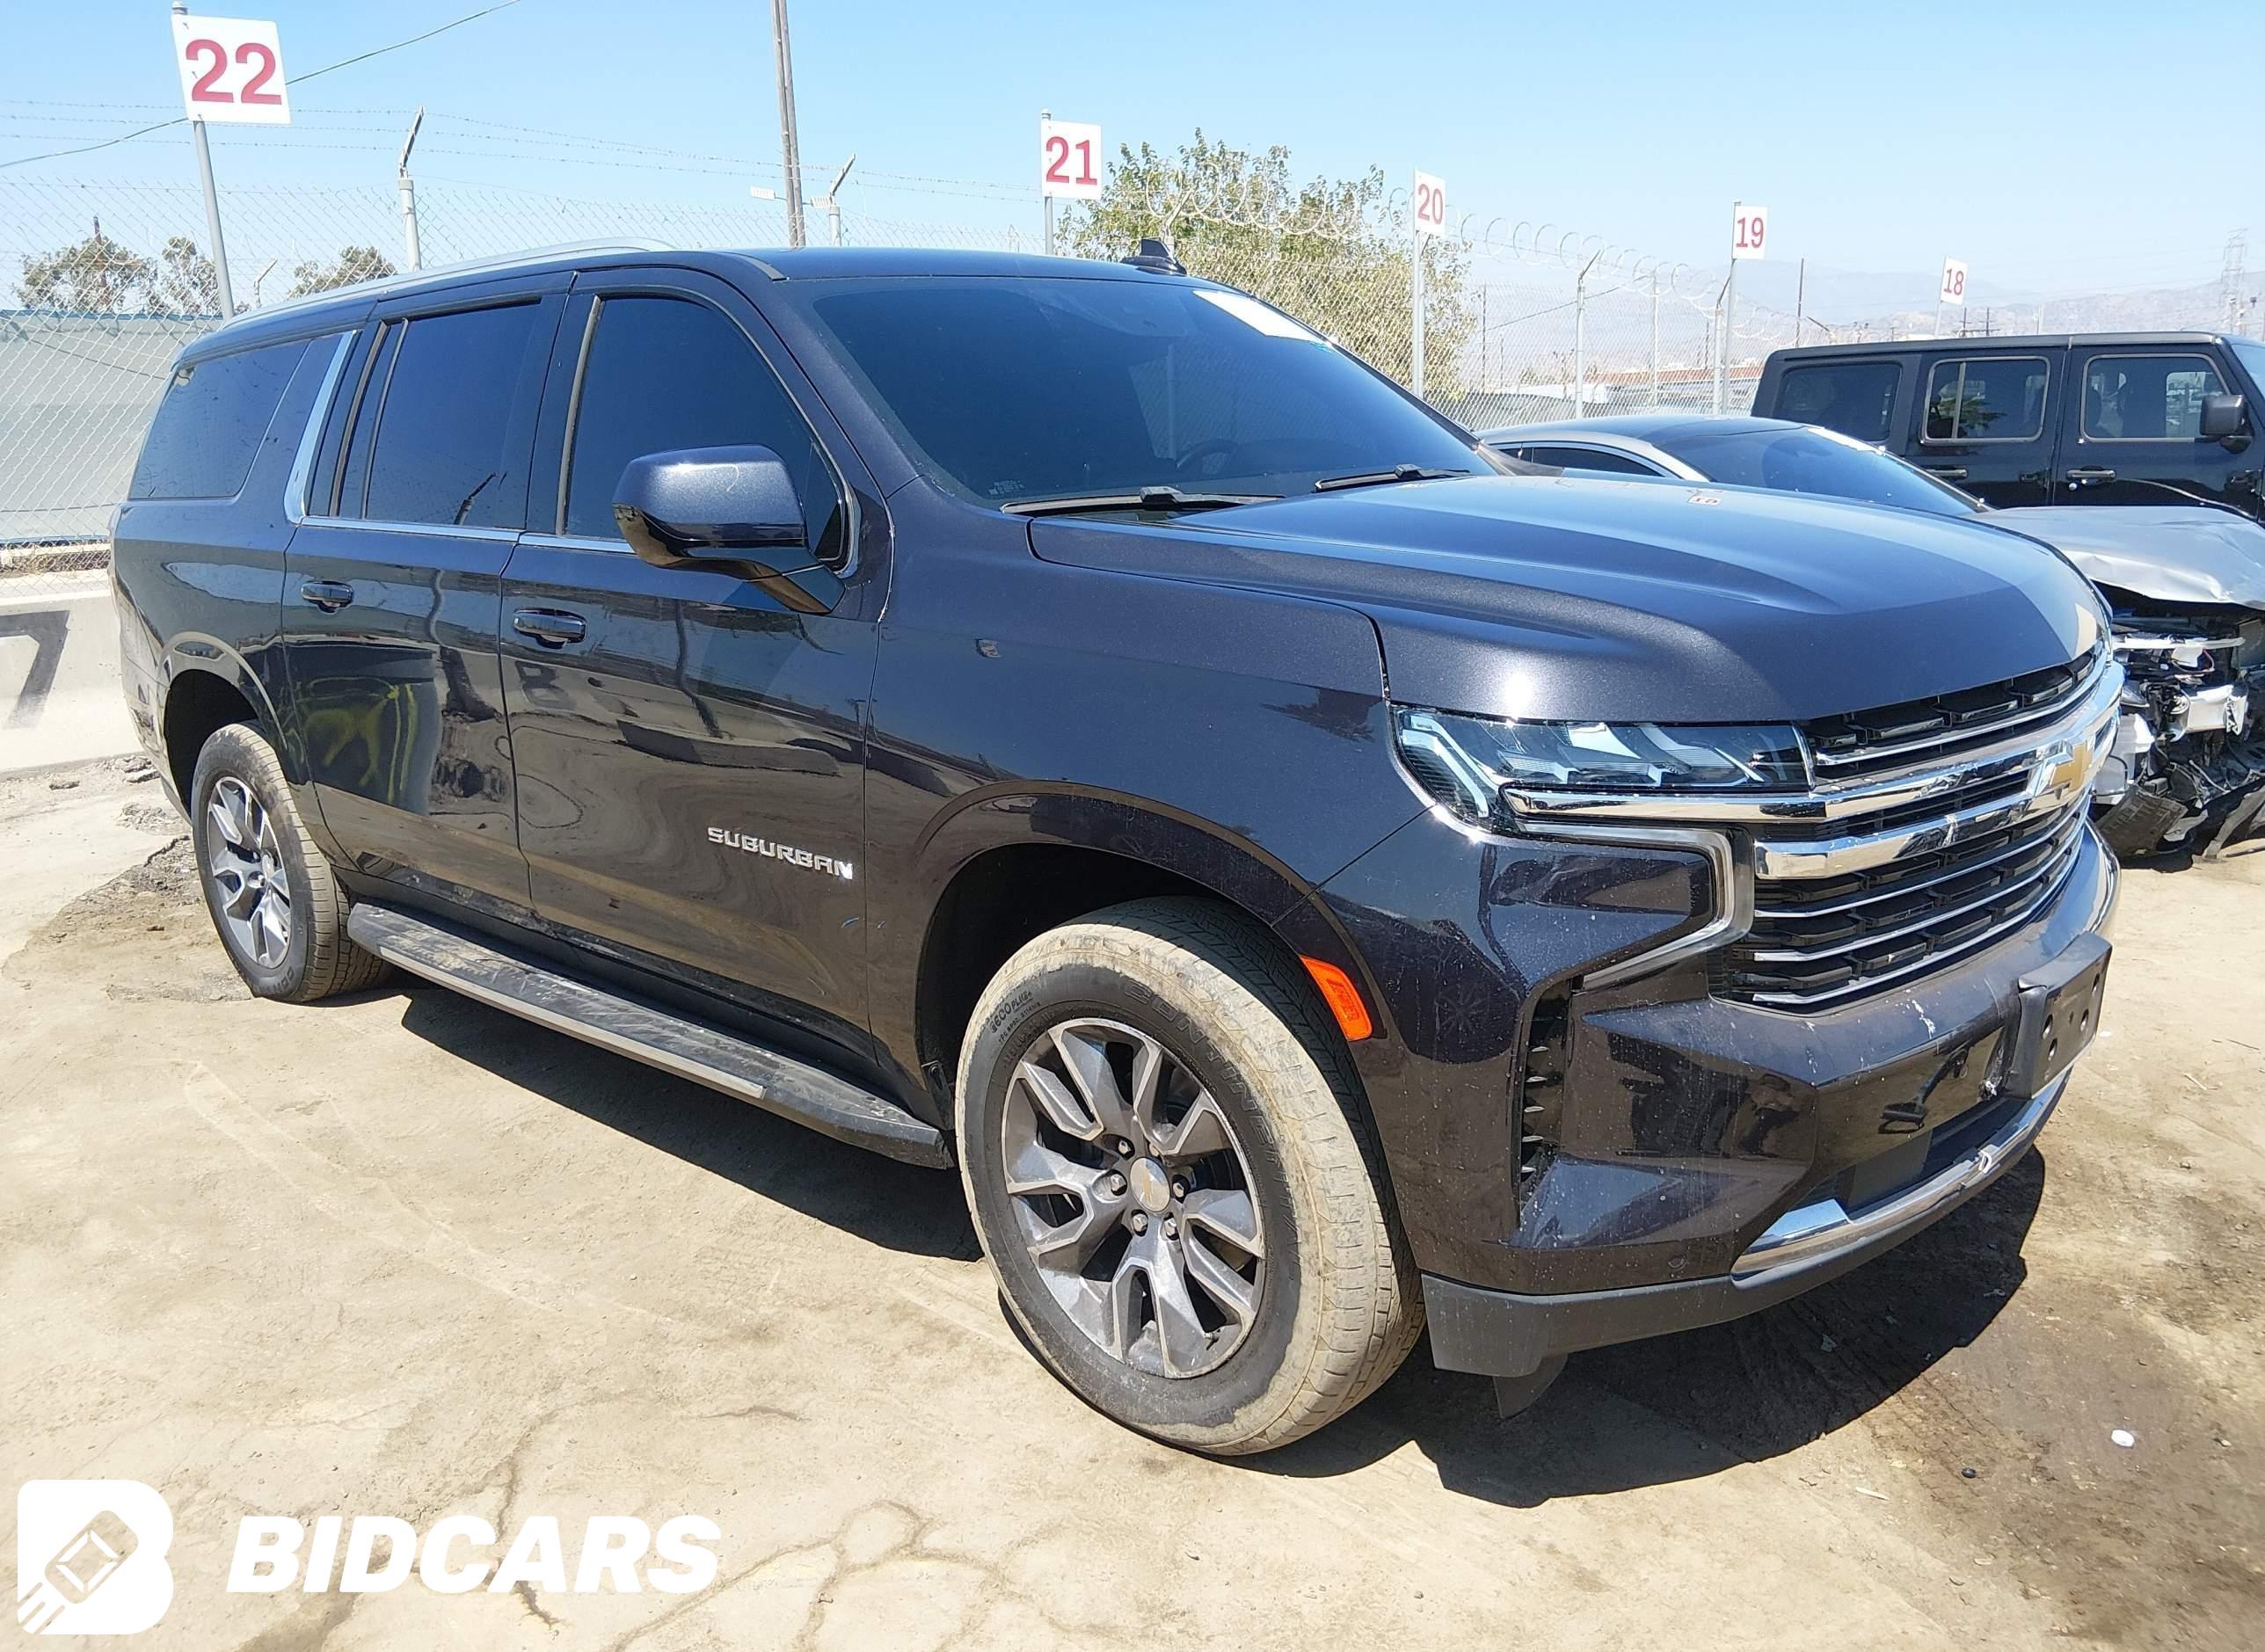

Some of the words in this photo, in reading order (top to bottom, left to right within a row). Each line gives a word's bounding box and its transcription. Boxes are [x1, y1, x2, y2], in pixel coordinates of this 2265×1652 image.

[186, 39, 282, 104] 22
[1045, 135, 1097, 186] 21
[1417, 184, 1444, 225] 20
[1736, 216, 1764, 248] 19
[1943, 268, 1964, 296] 18
[708, 826, 853, 879] SUBURBAN
